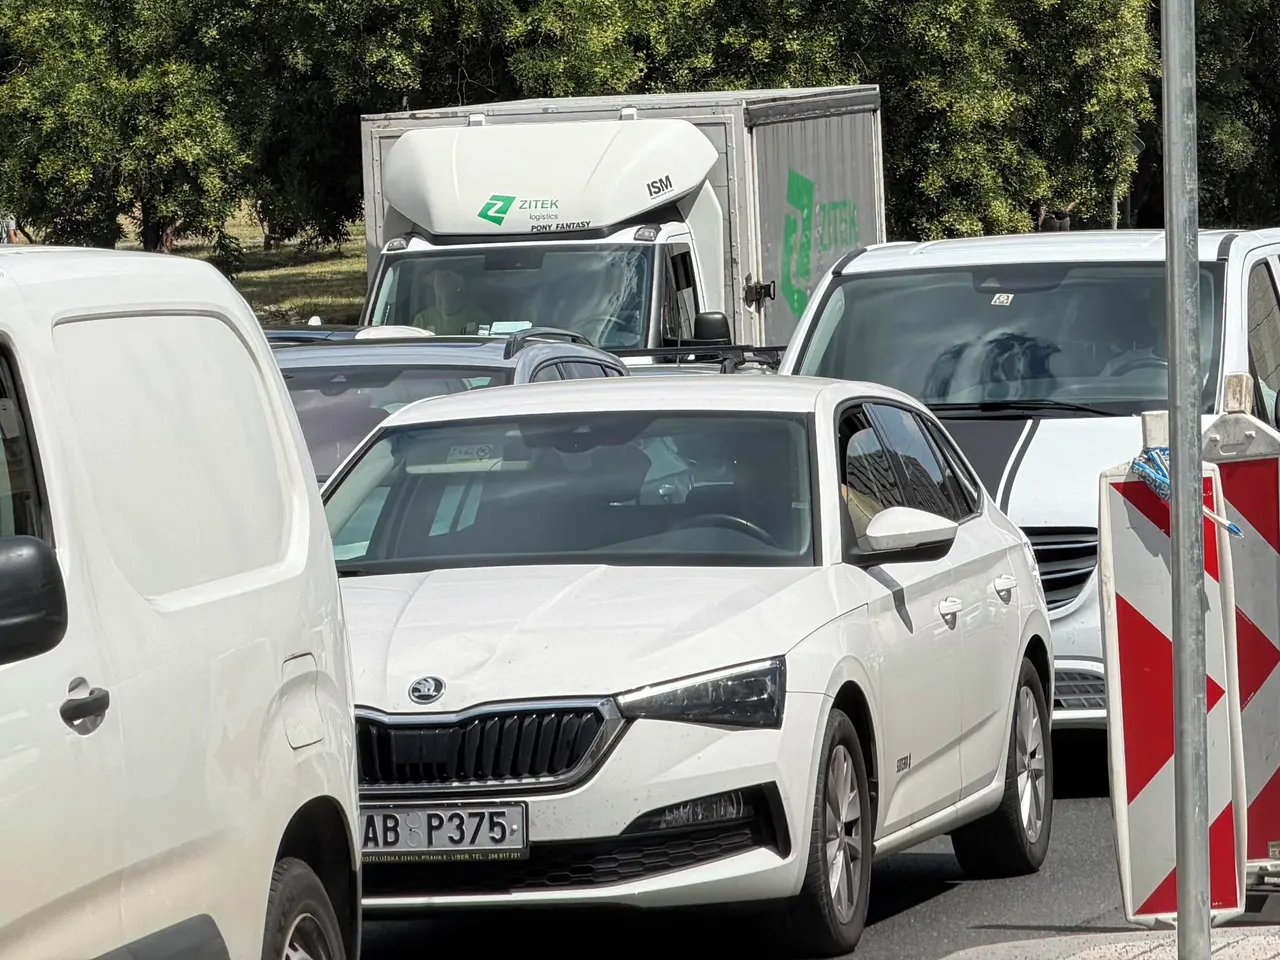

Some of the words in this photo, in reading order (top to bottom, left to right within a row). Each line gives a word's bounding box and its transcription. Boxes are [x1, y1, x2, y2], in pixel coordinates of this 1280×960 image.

[646, 174, 673, 197] ISM
[518, 199, 559, 210] ZITEK
[529, 212, 559, 221] logistics
[531, 224, 552, 232] PONY
[555, 221, 591, 231] FANTASY
[426, 810, 508, 845] P375
